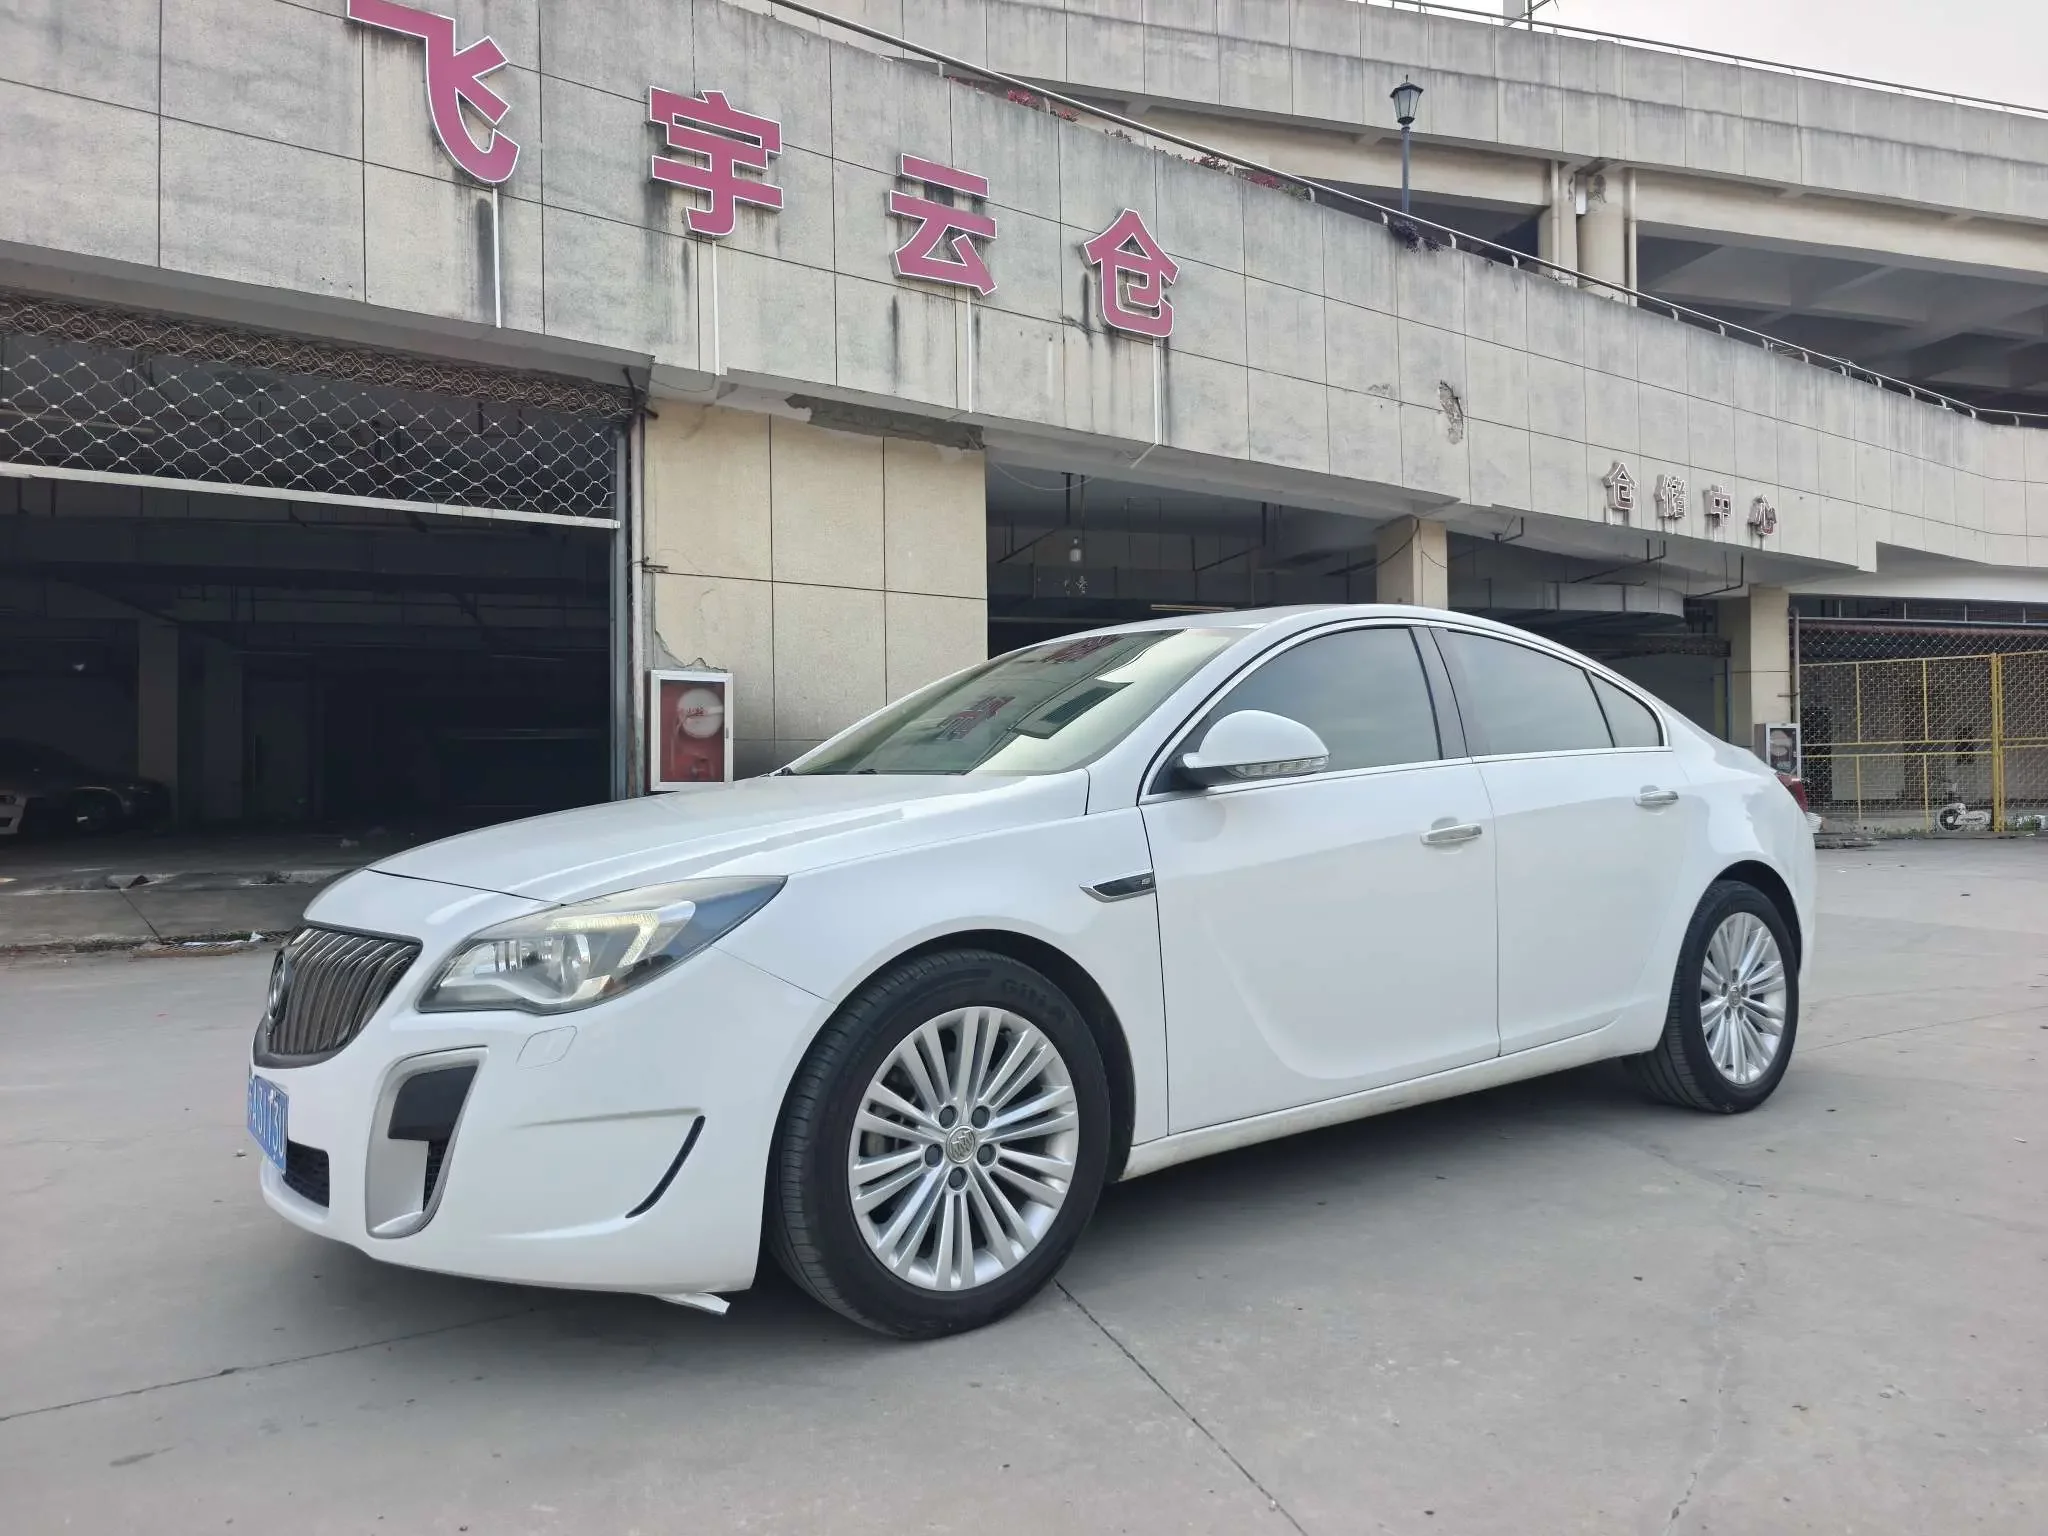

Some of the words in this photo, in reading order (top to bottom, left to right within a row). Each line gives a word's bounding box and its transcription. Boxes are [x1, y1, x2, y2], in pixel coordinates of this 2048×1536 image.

[347, 0, 1180, 338] 飞宇云仓
[1605, 462, 1776, 535] 仓储中心
